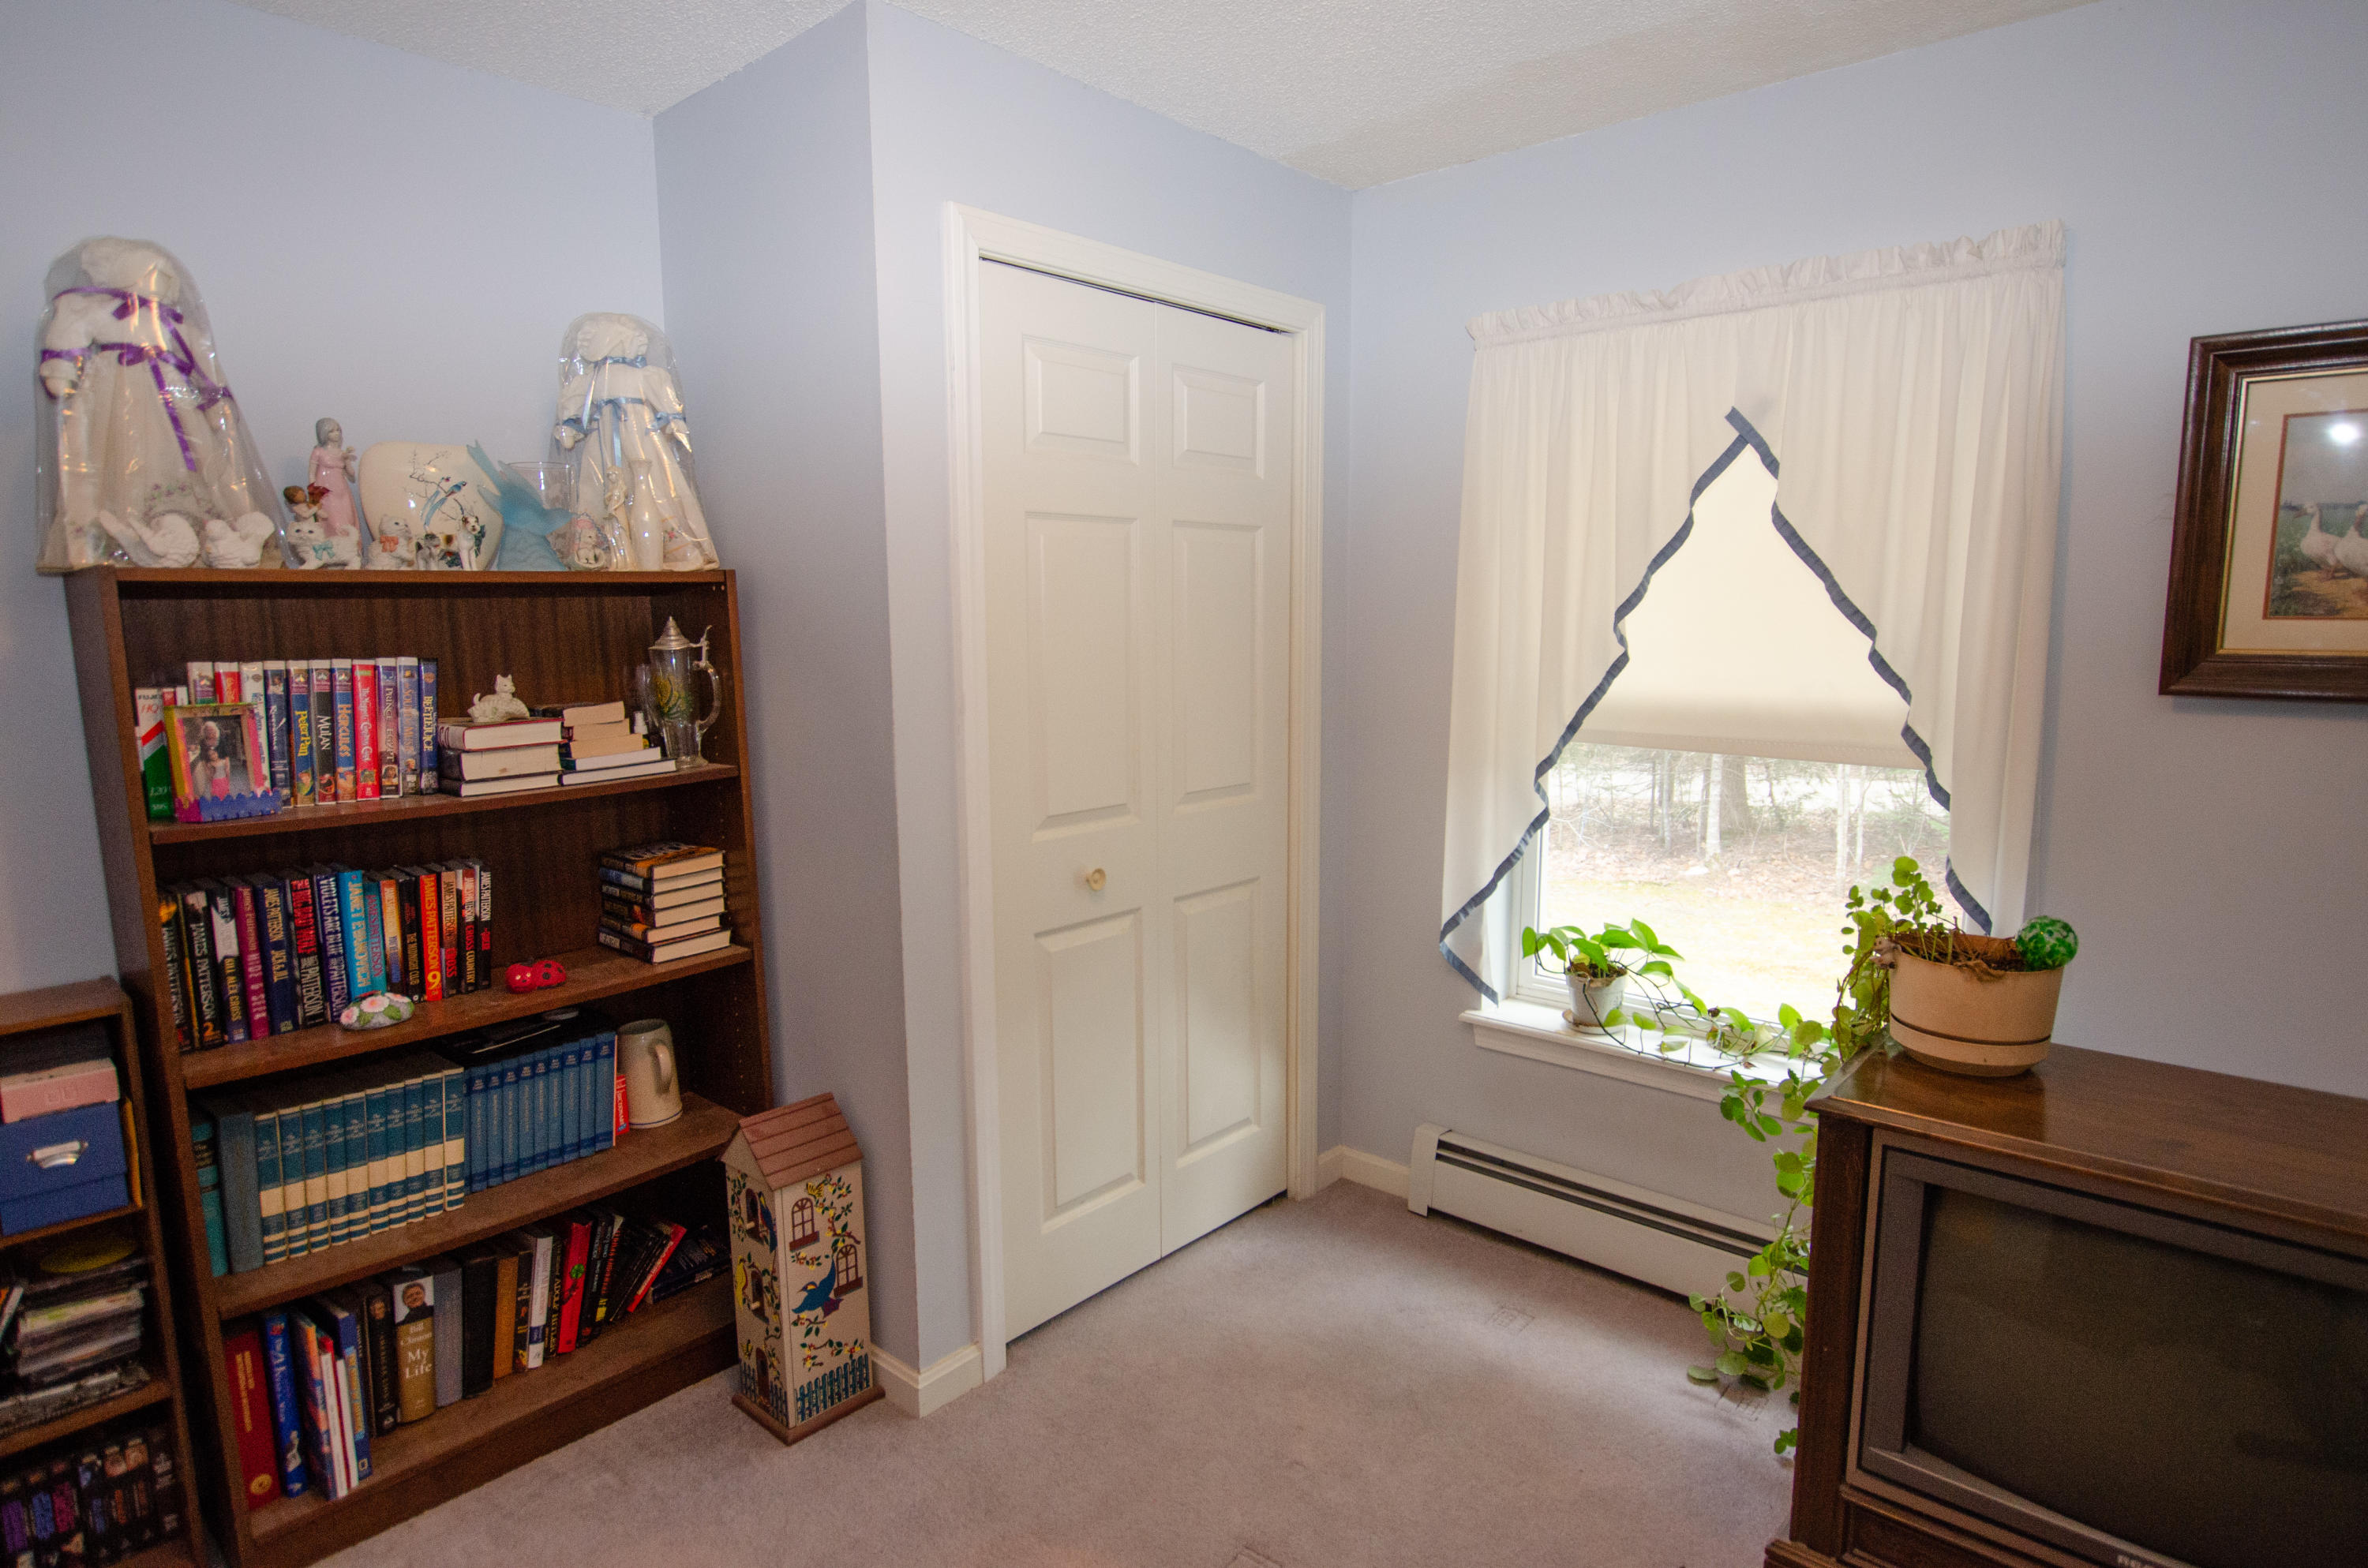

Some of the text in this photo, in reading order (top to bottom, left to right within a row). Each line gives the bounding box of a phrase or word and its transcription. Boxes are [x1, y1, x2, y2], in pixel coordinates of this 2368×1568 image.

[403, 689, 414, 720] SOUND
[295, 710, 312, 757] Peter Pan
[317, 715, 331, 750] MULAN
[338, 703, 351, 758] HERCULES
[384, 687, 395, 762] PRINCE EGYPT
[403, 726, 414, 753] MUSIC
[422, 695, 433, 752] BEETLEJUICE
[464, 877, 474, 893] JAMES
[480, 871, 491, 889] JAMES
[263, 888, 279, 908] JAMES
[480, 889, 491, 922] PATTERSON
[266, 907, 284, 942] PATTERSON
[291, 889, 317, 954] BIG BAD WOLF
[319, 877, 343, 956] VIOLETS ARE BLUE
[424, 876, 439, 971] JAMES PATTERSON
[443, 881, 457, 978] JAMES PATTERSON CROSS
[161, 926, 178, 960] JAMES
[347, 881, 371, 988] JANET EVANOVICH
[365, 893, 383, 978] JAMES PATTERSON
[465, 925, 474, 951] CROSS
[189, 922, 215, 1020] JAMES PATTERSON
[224, 957, 236, 975] KILL
[246, 952, 262, 979] HIDE
[271, 949, 287, 965] JACK
[407, 943, 419, 971] MIDNIGHT
[466, 951, 476, 984] COUNTRY
[167, 962, 186, 1024] PATTERSON
[227, 975, 239, 995] ALEX
[301, 966, 324, 1016] PATTERSON
[329, 965, 348, 1016] PATTERSON
[229, 994, 242, 1022] CROSS
[552, 1278, 561, 1311] ADOLF
[549, 1313, 560, 1353] HITLER
[404, 1362, 433, 1379] Life
[407, 1348, 429, 1364] My
